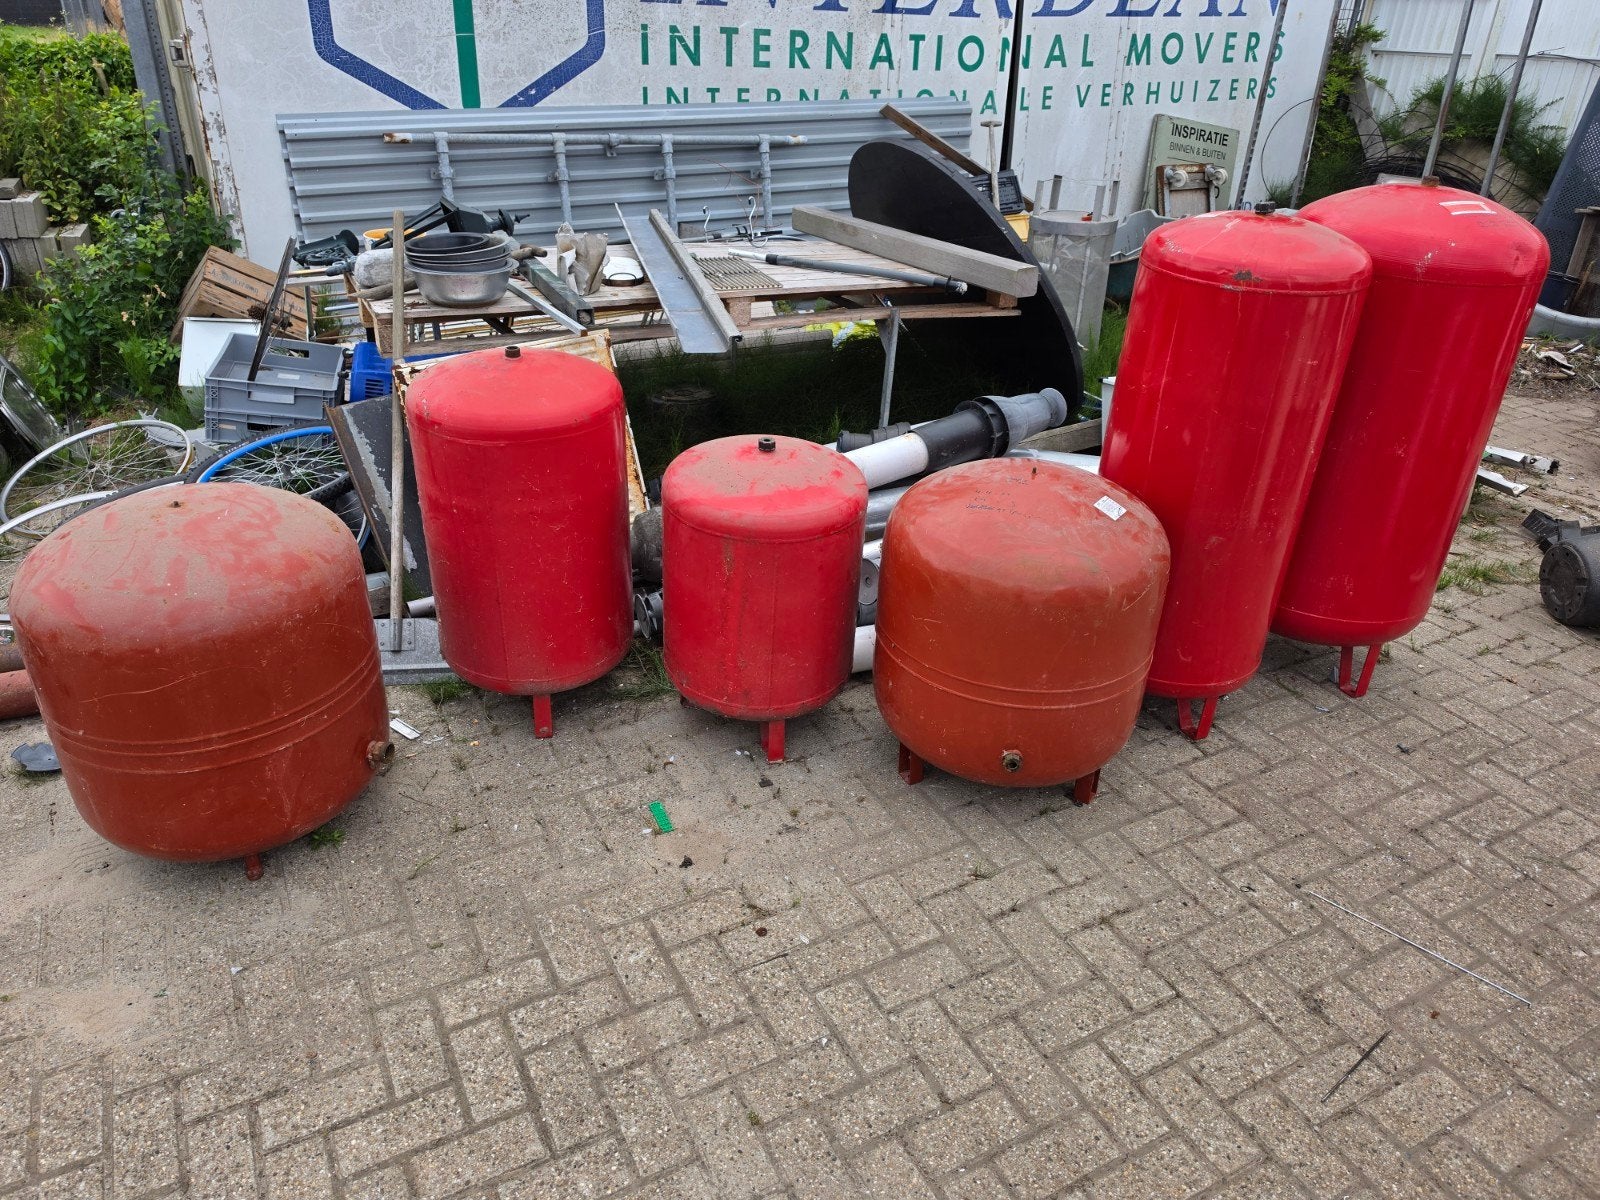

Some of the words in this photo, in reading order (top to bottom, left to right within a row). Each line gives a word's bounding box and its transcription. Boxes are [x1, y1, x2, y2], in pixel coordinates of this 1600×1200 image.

[640, 23, 1094, 73] INTERNATIONAL
[1125, 31, 1286, 67] MOVERS
[1076, 76, 1278, 108] VERHUIZERS
[1171, 122, 1230, 147] INSPIRATIE
[1169, 141, 1196, 155] BINNEN
[1195, 147, 1201, 156] &
[1202, 147, 1227, 160] BUITEN
